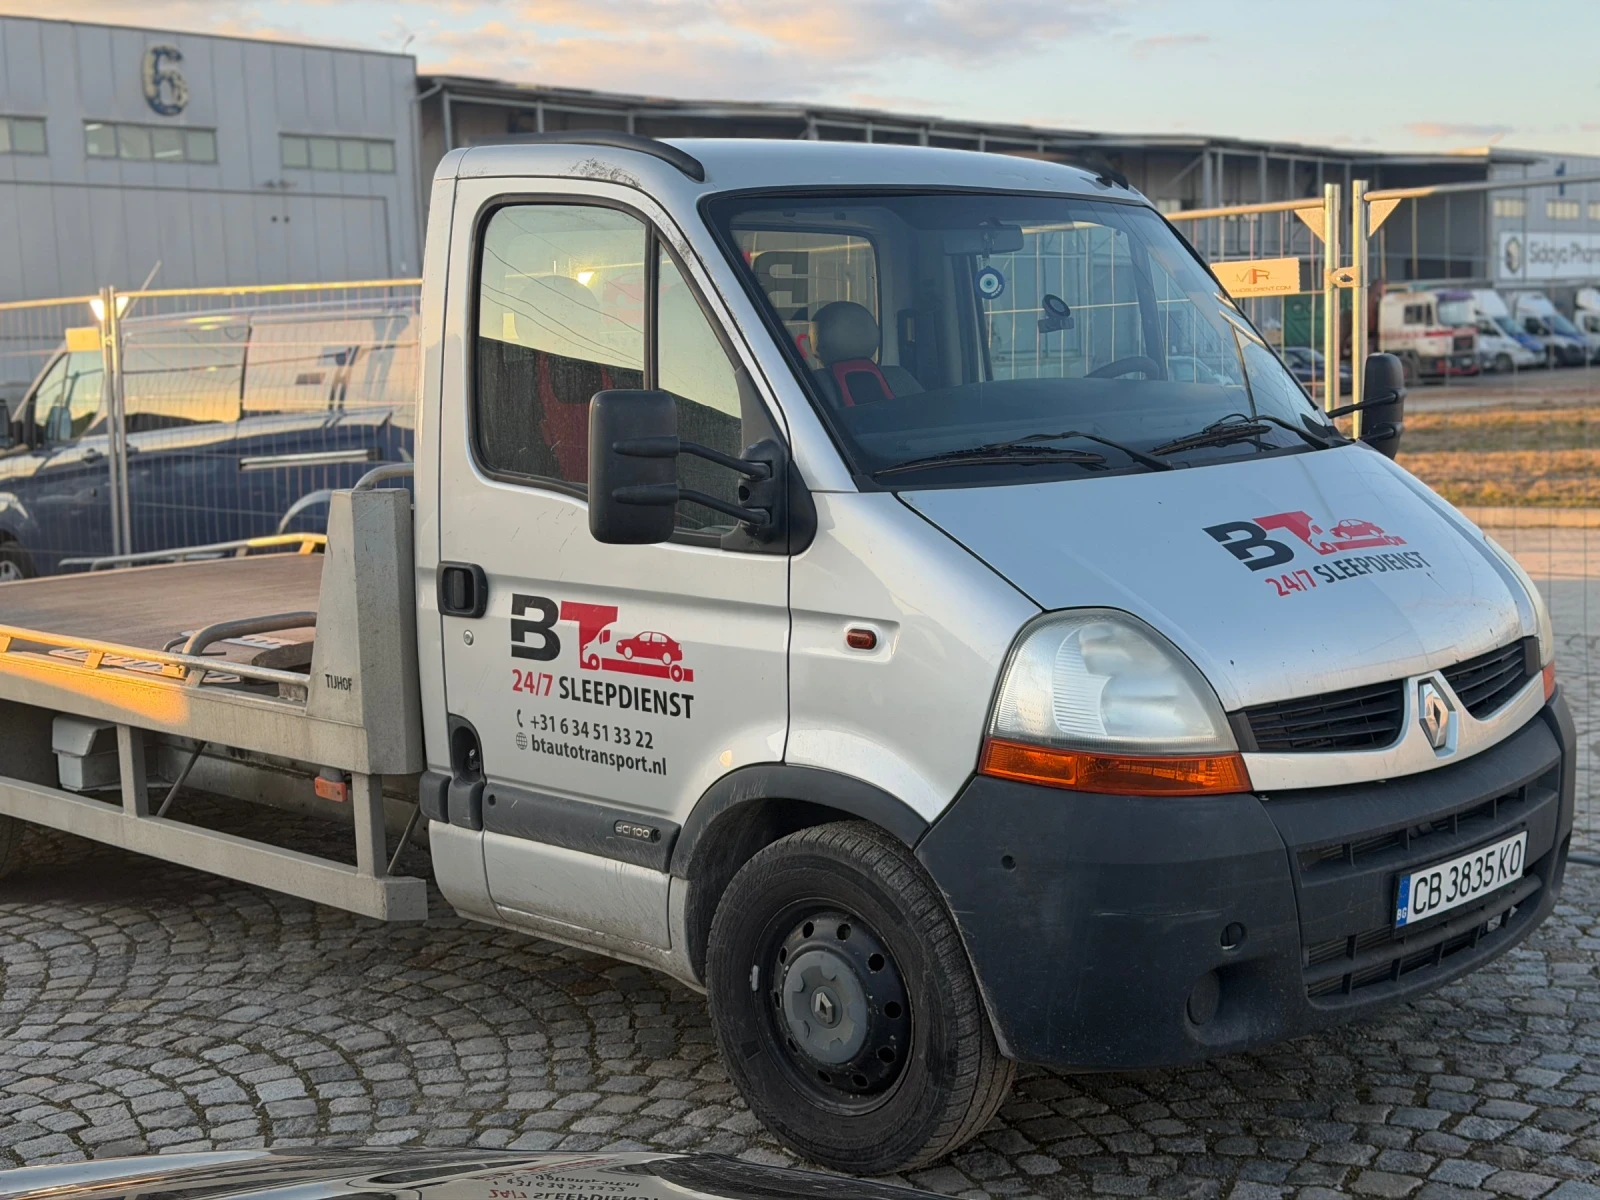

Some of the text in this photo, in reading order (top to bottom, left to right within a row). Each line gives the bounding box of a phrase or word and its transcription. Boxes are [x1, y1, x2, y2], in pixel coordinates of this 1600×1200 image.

[142, 45, 188, 116] 6
[1265, 551, 1432, 596] 24/7 SLEEPDIENST
[325, 673, 353, 691] TIJHOF
[512, 668, 695, 719] 24/7 SLEEPDIENST
[530, 714, 654, 750] +31 6 34 51 33 22
[531, 734, 667, 776] btautotransport.nl
[1446, 850, 1496, 903] 3835
[1397, 906, 1408, 921] BG
